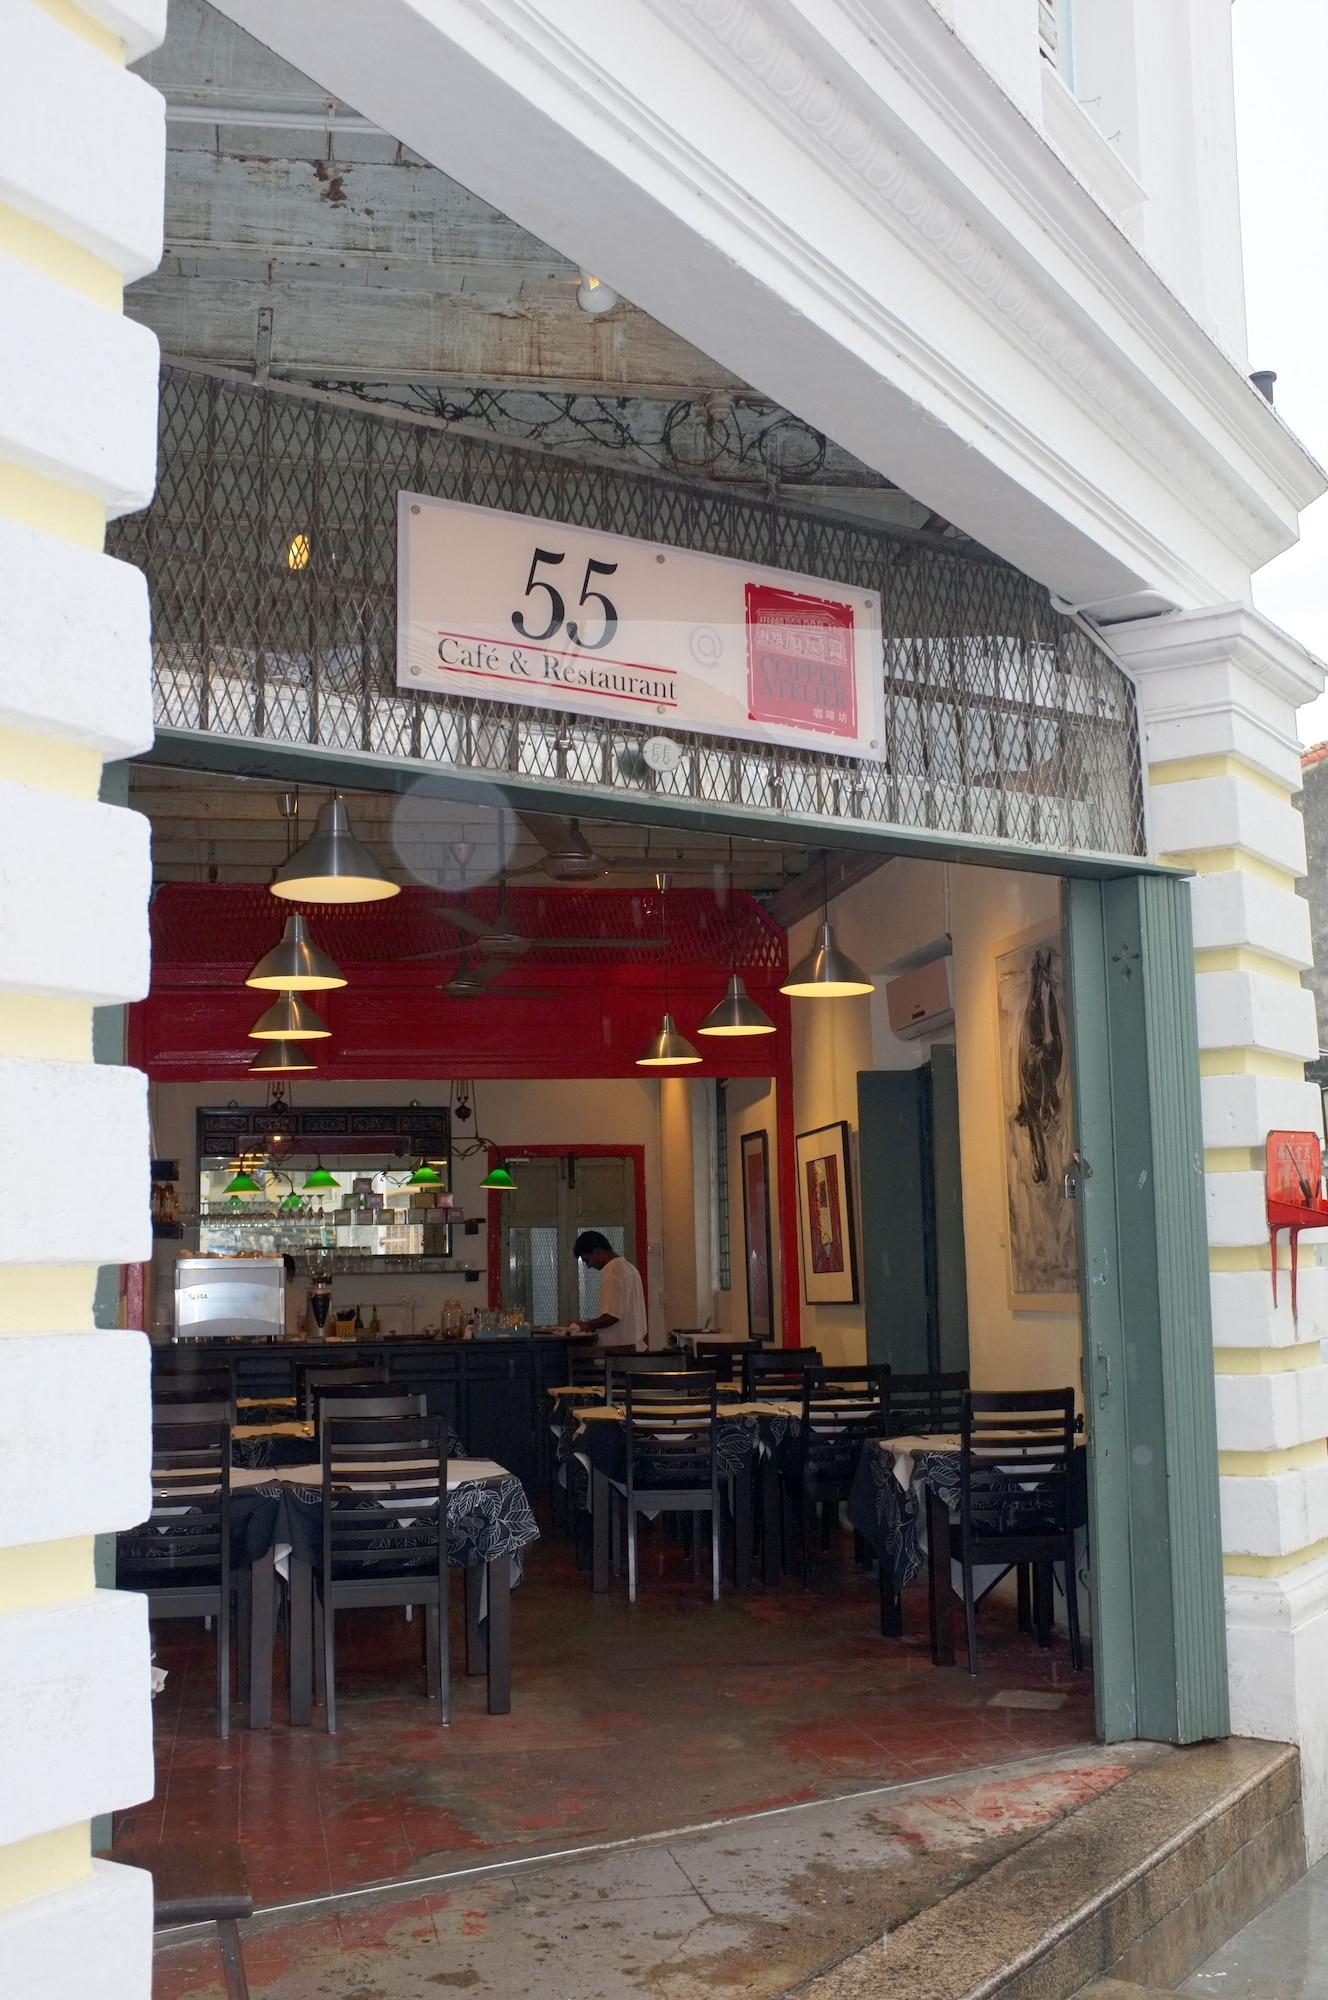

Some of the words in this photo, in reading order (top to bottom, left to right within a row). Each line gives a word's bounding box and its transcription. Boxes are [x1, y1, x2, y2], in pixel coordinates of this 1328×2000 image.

[511, 547, 618, 649] 55
[690, 625, 724, 667] @
[438, 639, 499, 671] Café
[510, 649, 531, 676] &
[544, 655, 678, 700] Restaurant
[760, 656, 843, 689] COFFEE
[761, 679, 847, 710] ATELIER
[652, 743, 673, 765] 55
